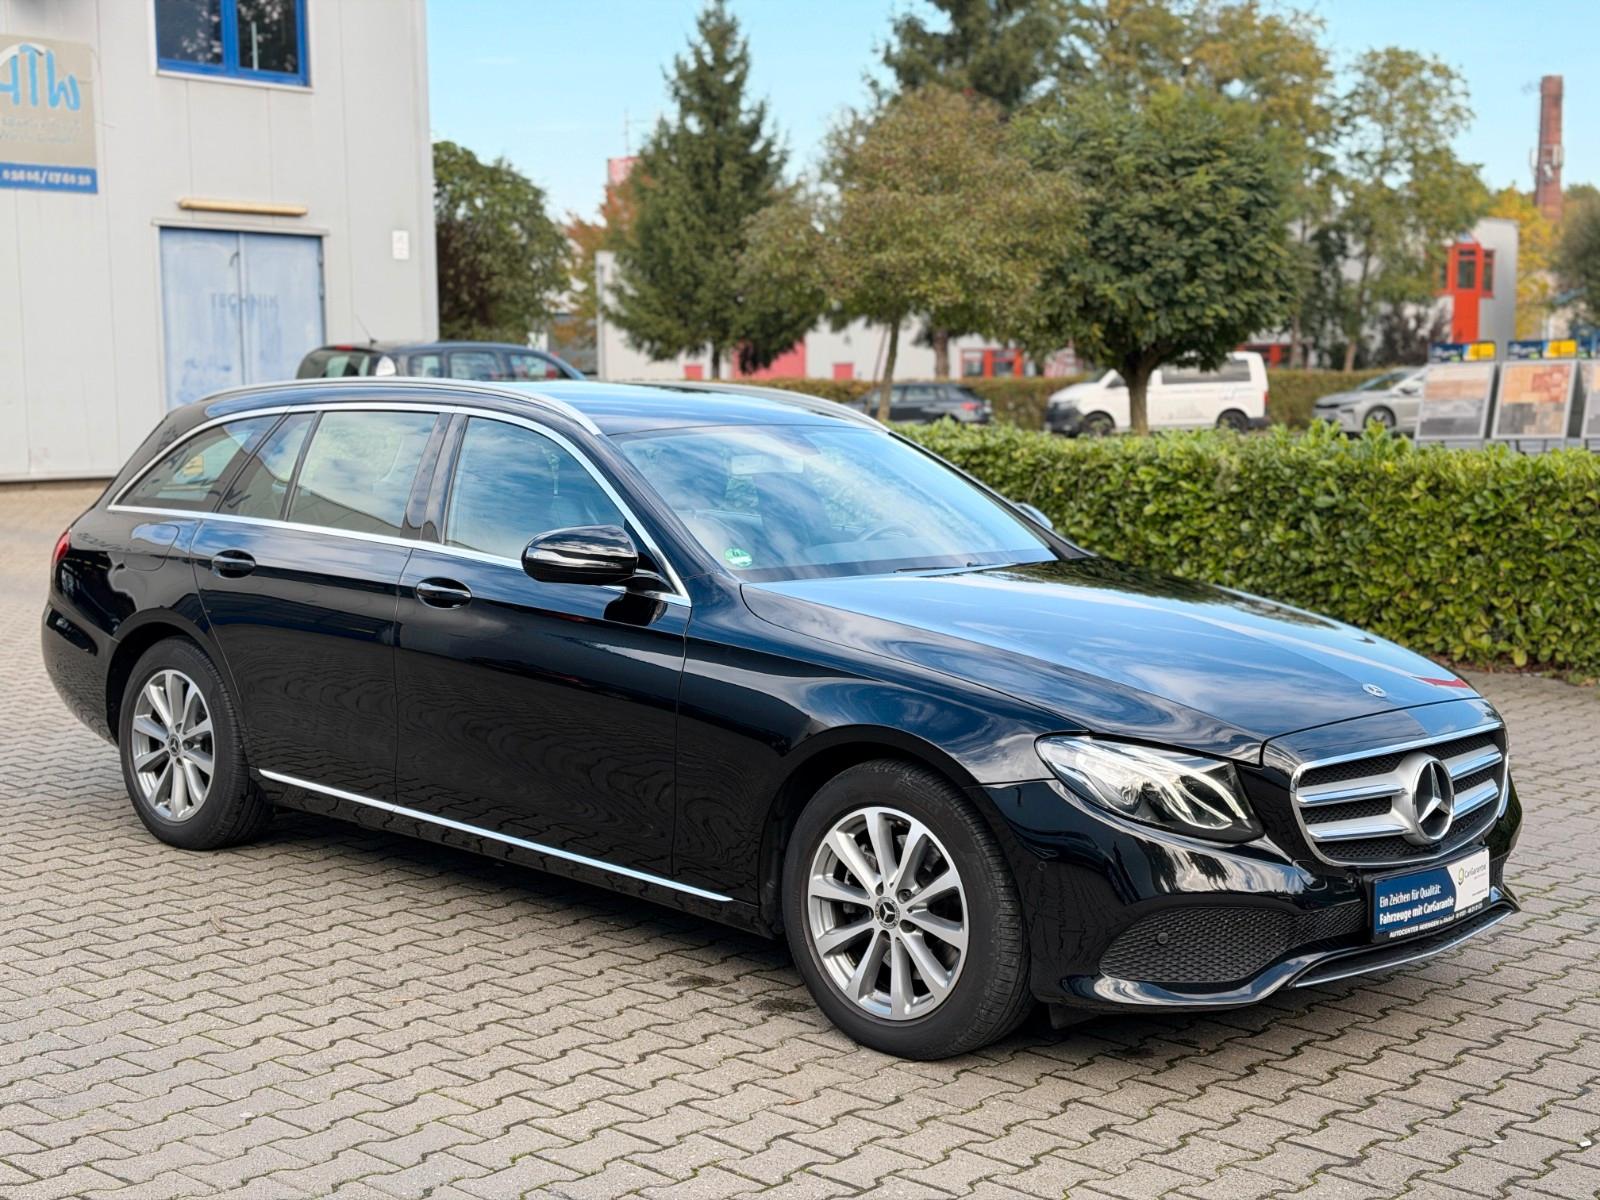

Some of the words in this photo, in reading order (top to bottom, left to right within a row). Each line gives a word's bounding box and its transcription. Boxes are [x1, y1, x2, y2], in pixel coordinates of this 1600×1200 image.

[1380, 896, 1389, 908] Ein
[1389, 891, 1411, 906] Zeichen
[1411, 888, 1420, 901] für
[1380, 909, 1412, 925] Fahrzeuge
[1412, 904, 1423, 918] mit
[1423, 895, 1454, 914] CarGarantie
